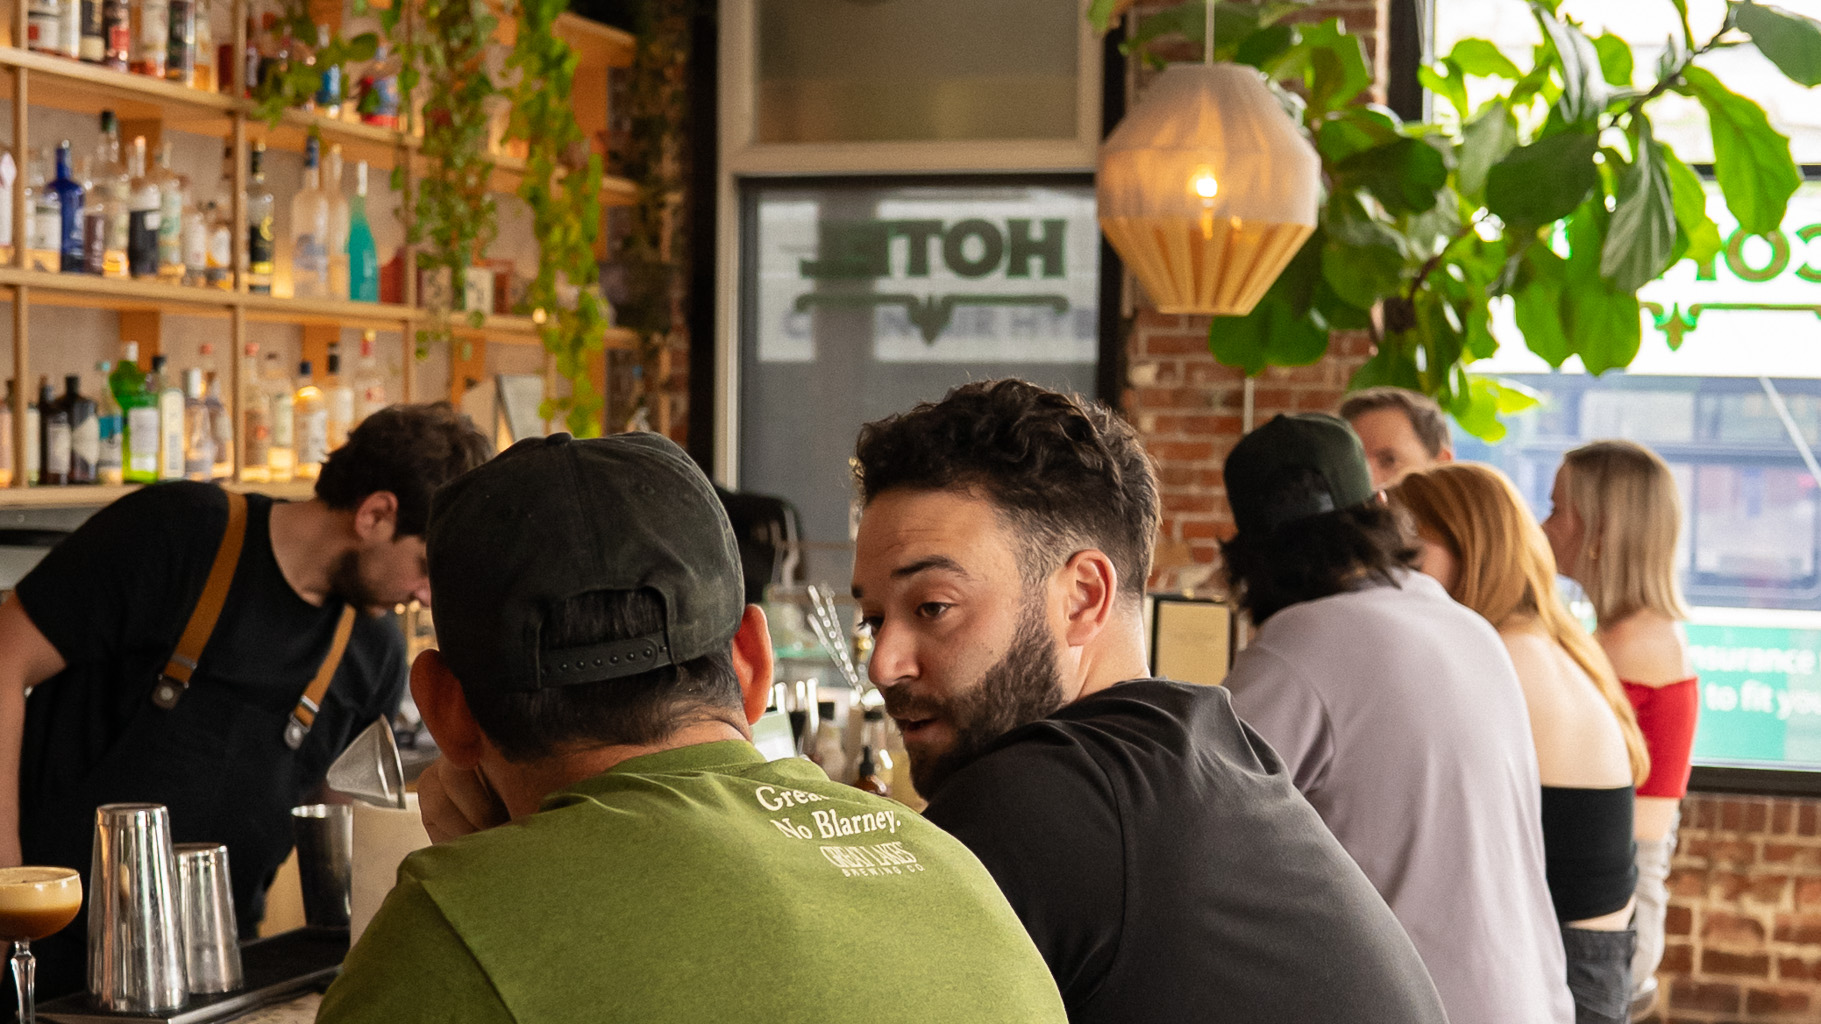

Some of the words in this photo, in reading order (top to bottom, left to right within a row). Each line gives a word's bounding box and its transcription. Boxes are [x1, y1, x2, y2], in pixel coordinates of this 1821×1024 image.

[1705, 682, 1738, 711] to
[1740, 679, 1774, 713] fit
[755, 786, 829, 811] Grea
[770, 817, 813, 840] No
[811, 808, 901, 839] Blarney.
[820, 845, 875, 868] GREAT
[871, 841, 917, 866] LAKES
[841, 866, 902, 878] BREWING
